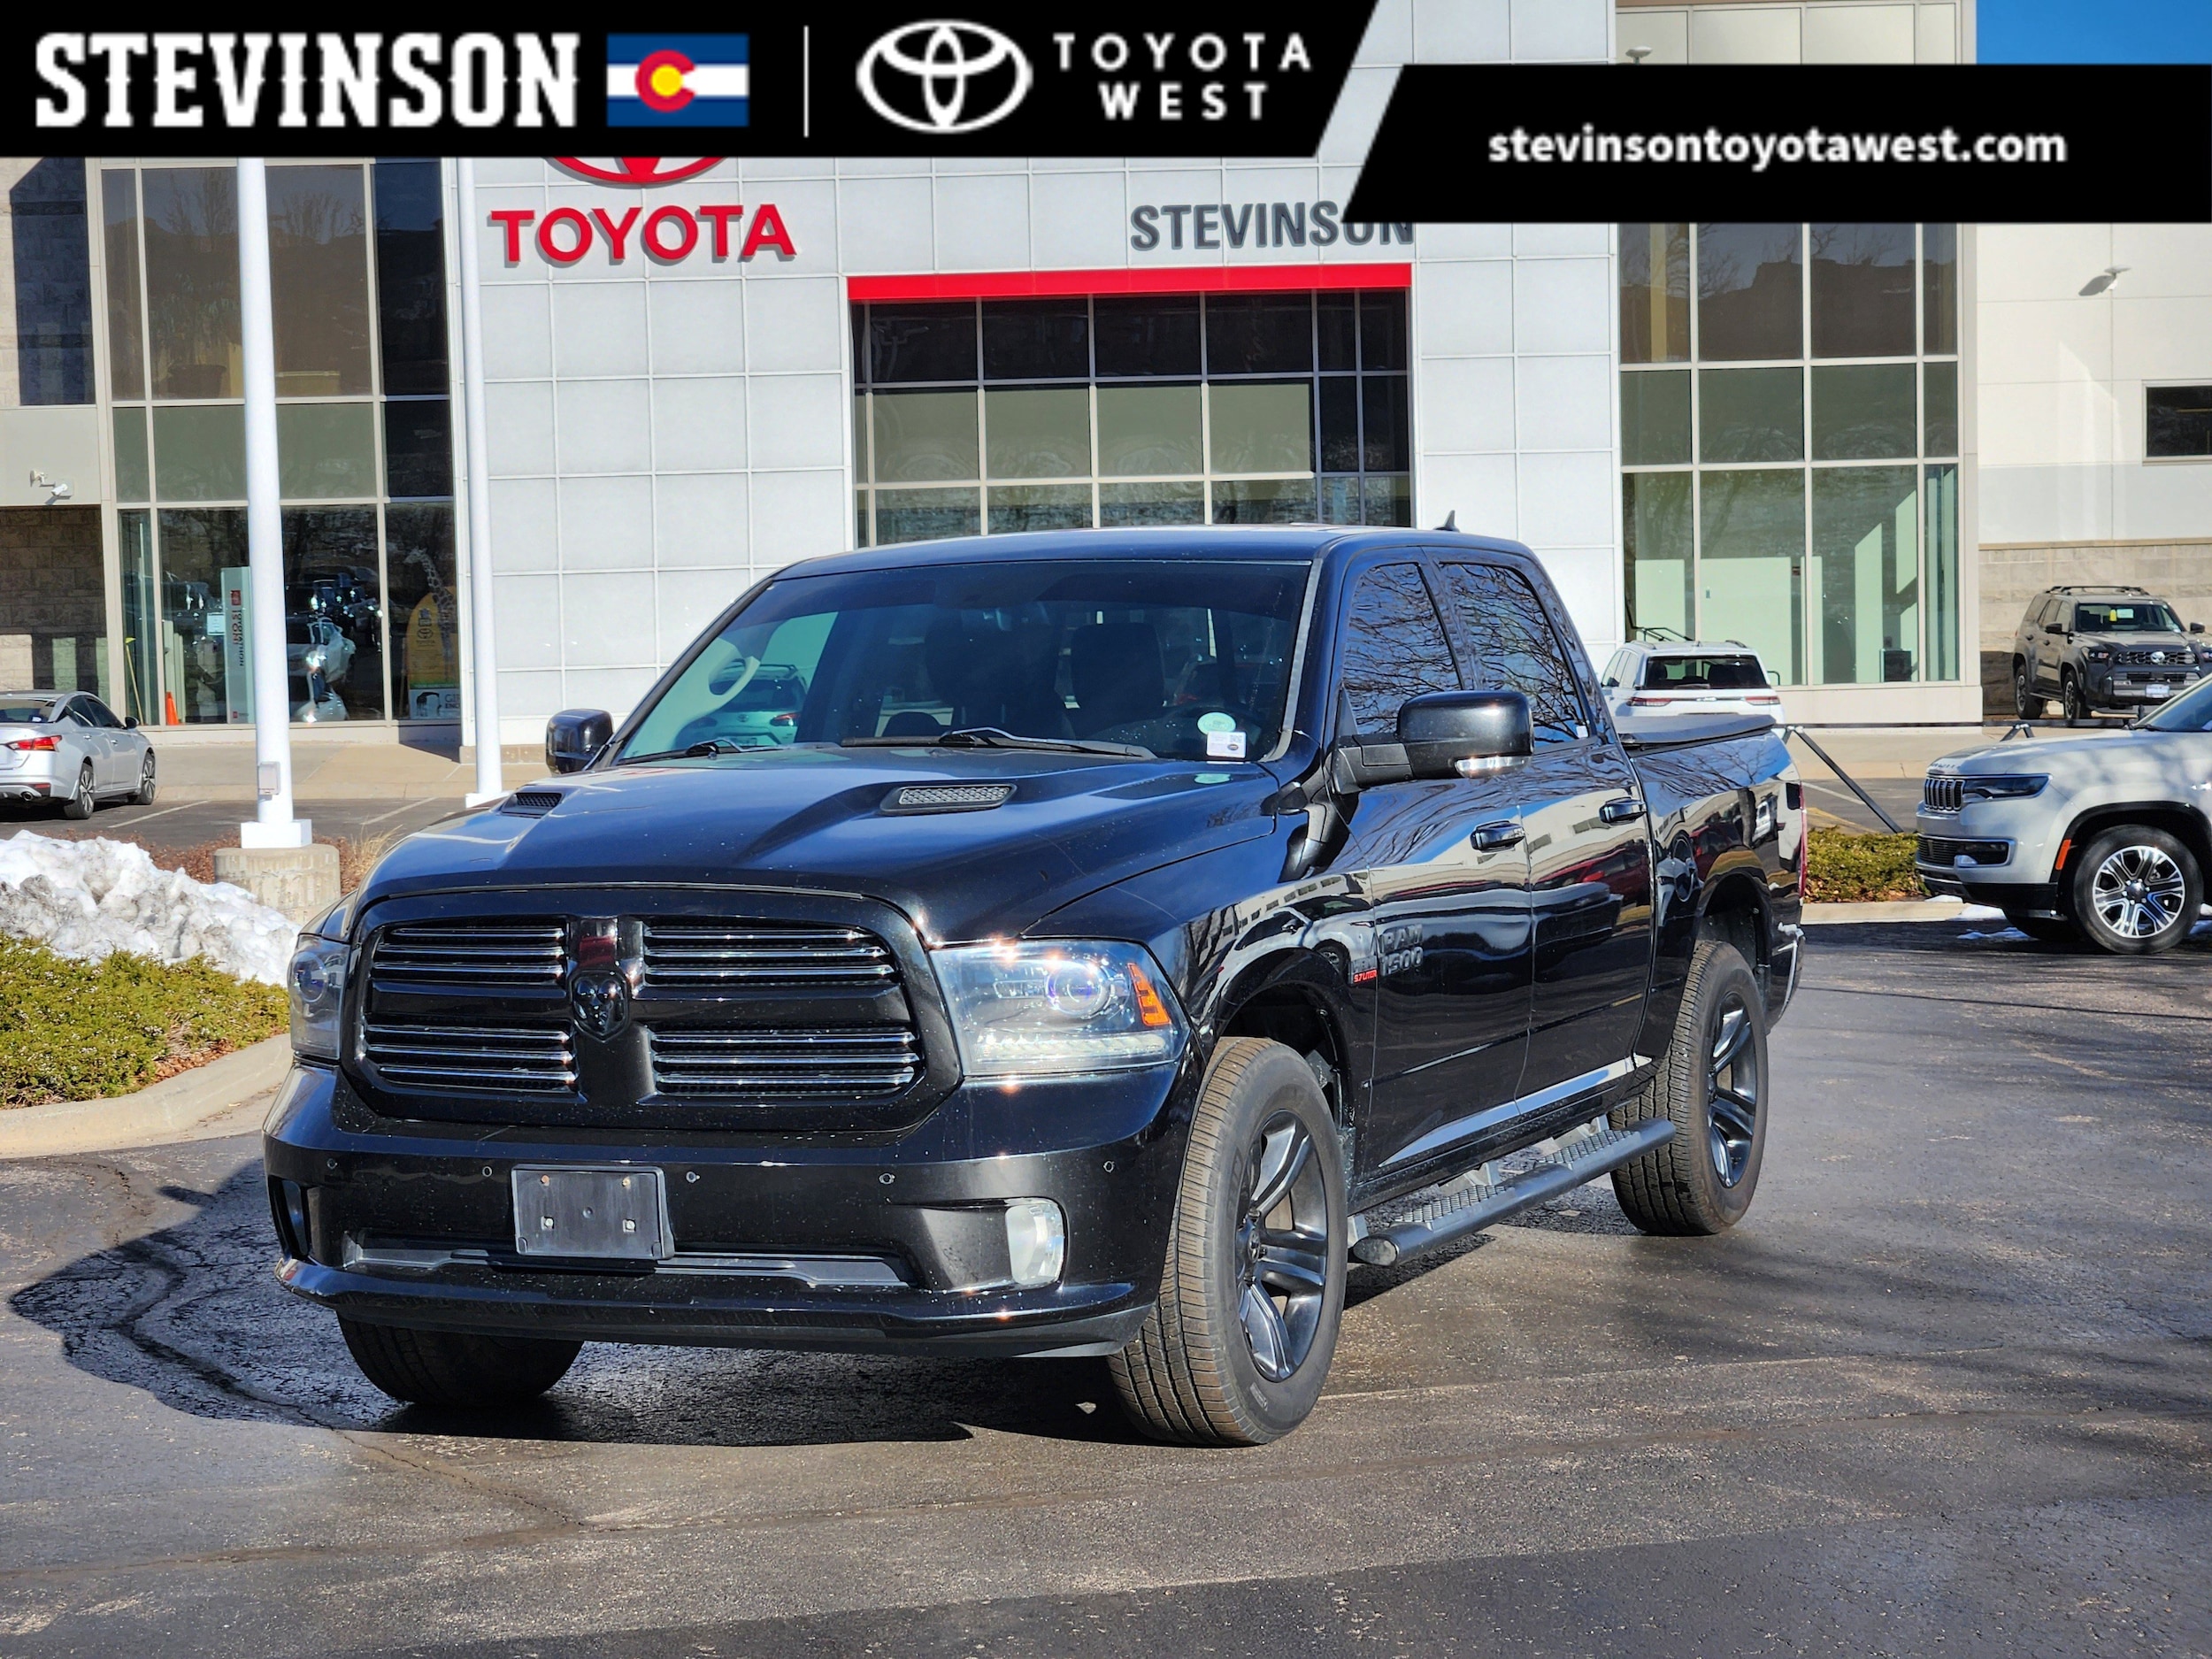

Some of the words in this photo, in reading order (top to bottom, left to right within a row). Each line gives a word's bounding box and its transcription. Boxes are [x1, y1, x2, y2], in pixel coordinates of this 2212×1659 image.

[490, 204, 797, 263] TOYOTA
[1380, 924, 1423, 955] RAM
[1380, 946, 1424, 977] 1500
